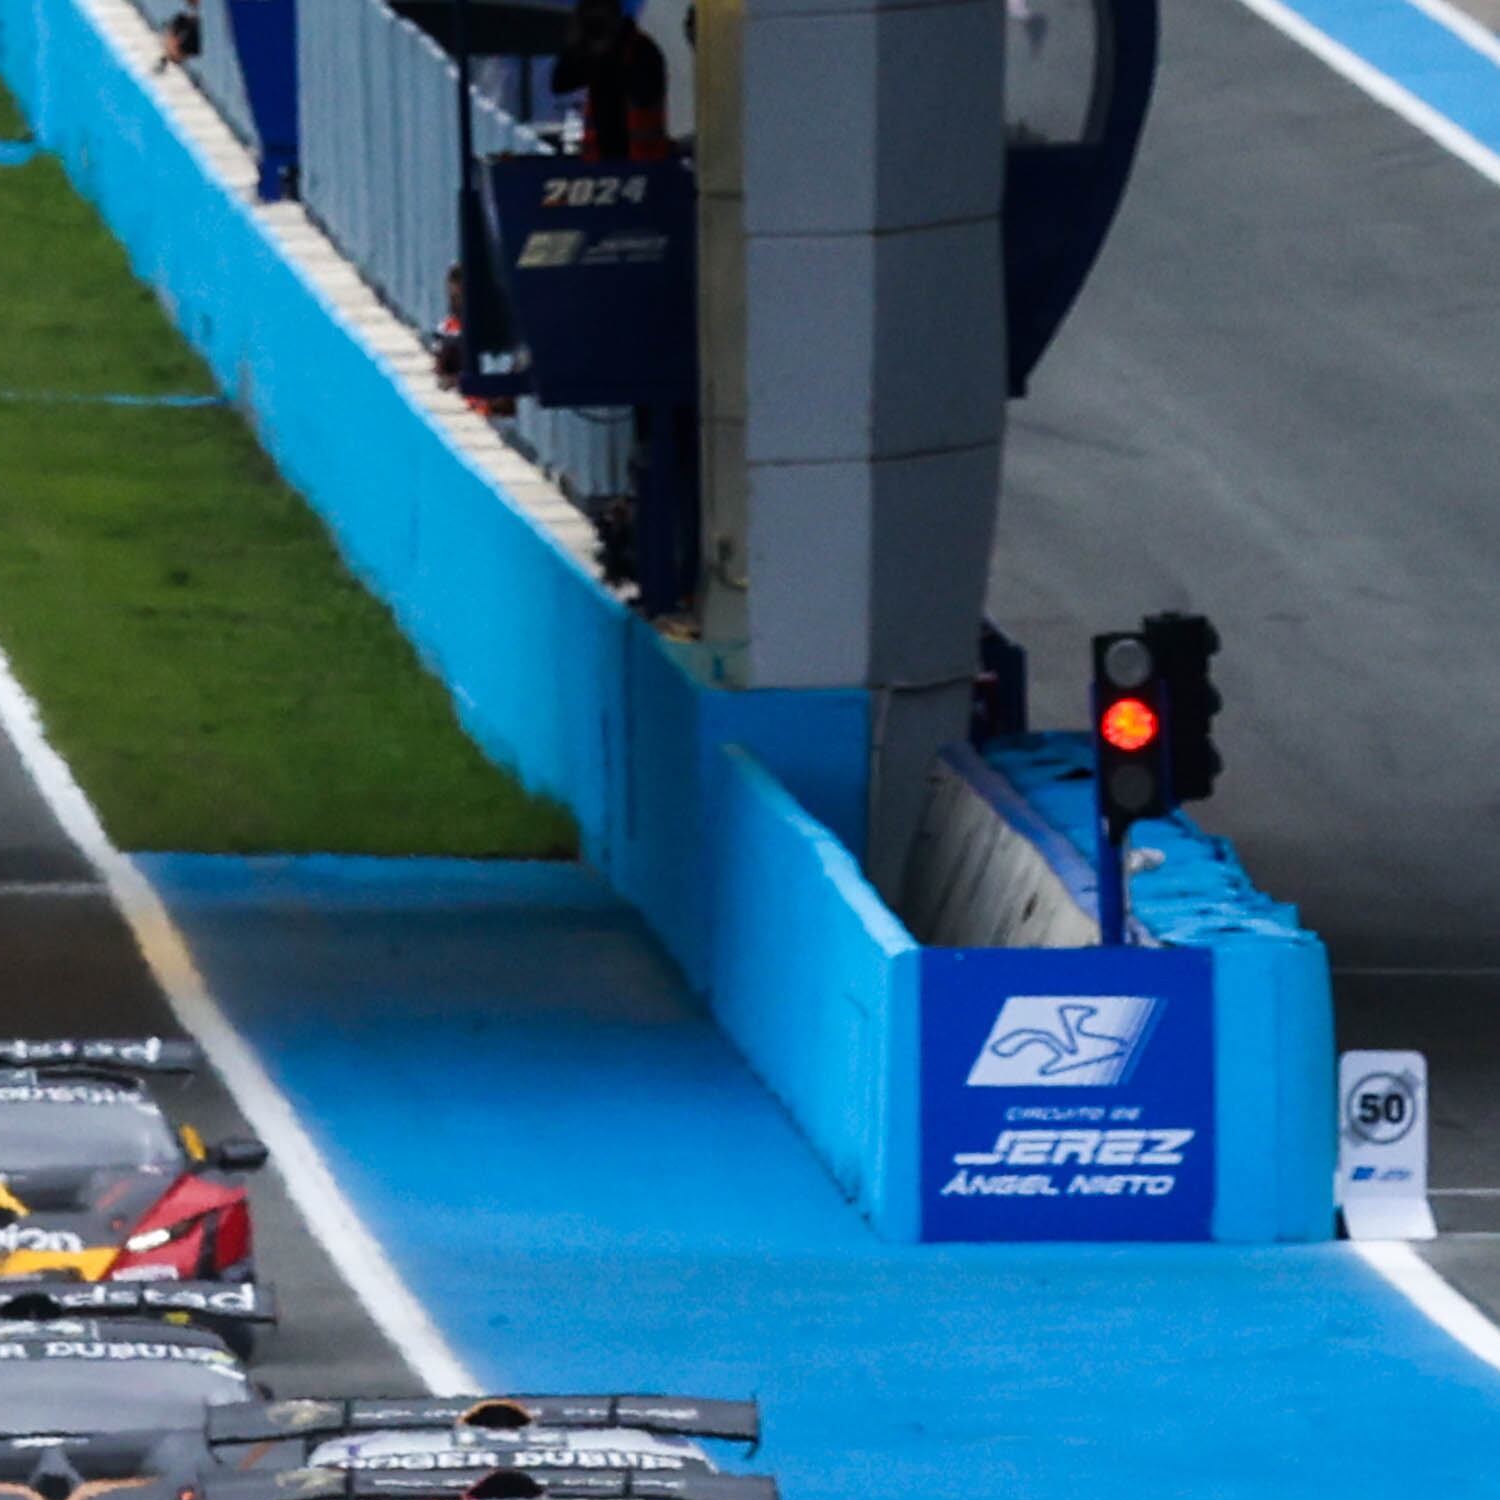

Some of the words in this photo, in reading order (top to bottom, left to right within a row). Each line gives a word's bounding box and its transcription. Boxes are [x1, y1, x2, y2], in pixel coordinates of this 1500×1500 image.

[540, 175, 648, 207] 2024
[1006, 1106, 1104, 1122] CIRCUITO
[1358, 1094, 1406, 1124] 50
[953, 1129, 1195, 1166] JEREZ
[941, 1167, 1060, 1197] ÁNGEL
[1068, 1174, 1175, 1196] NIETO
